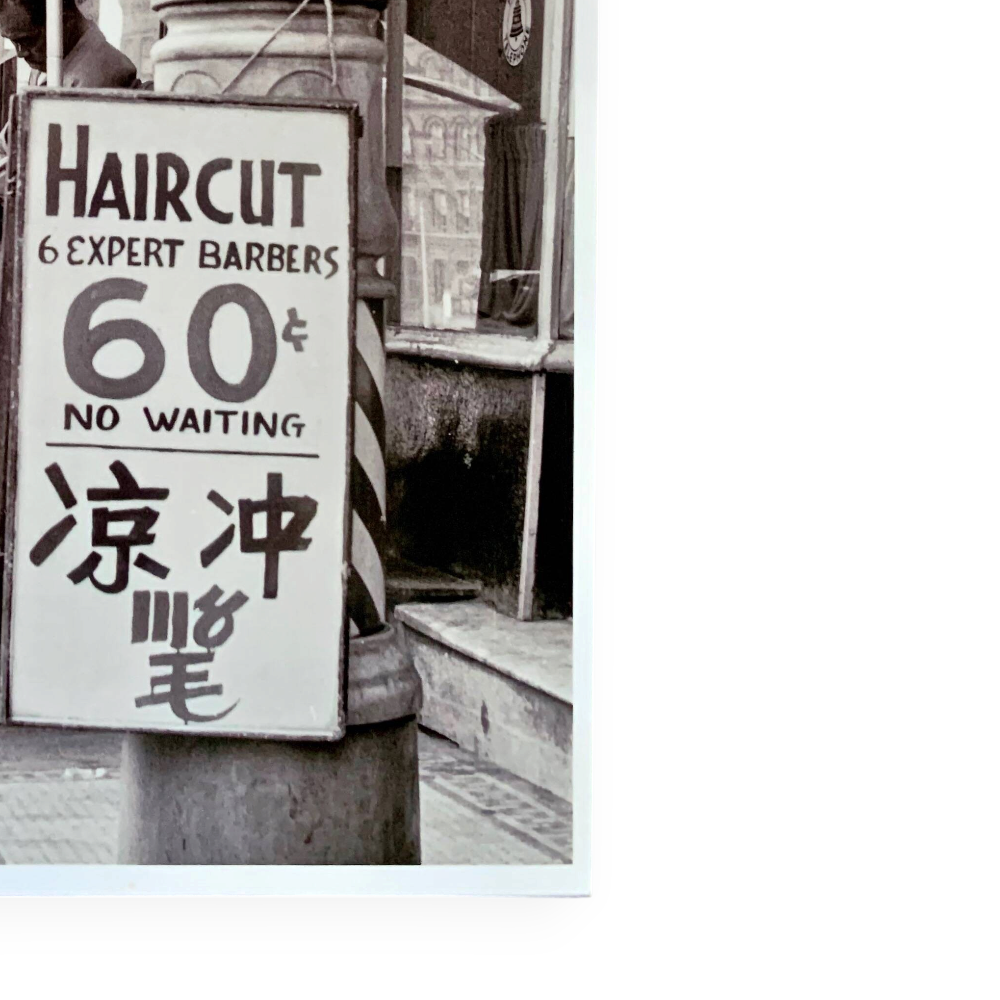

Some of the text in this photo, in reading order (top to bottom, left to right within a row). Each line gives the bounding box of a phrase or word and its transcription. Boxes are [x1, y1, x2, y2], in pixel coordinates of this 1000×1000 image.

[45, 123, 322, 227] HAIRCUT
[38, 235, 339, 279] 6 EXPERT BARBERS
[63, 404, 306, 438] NO WAITING
